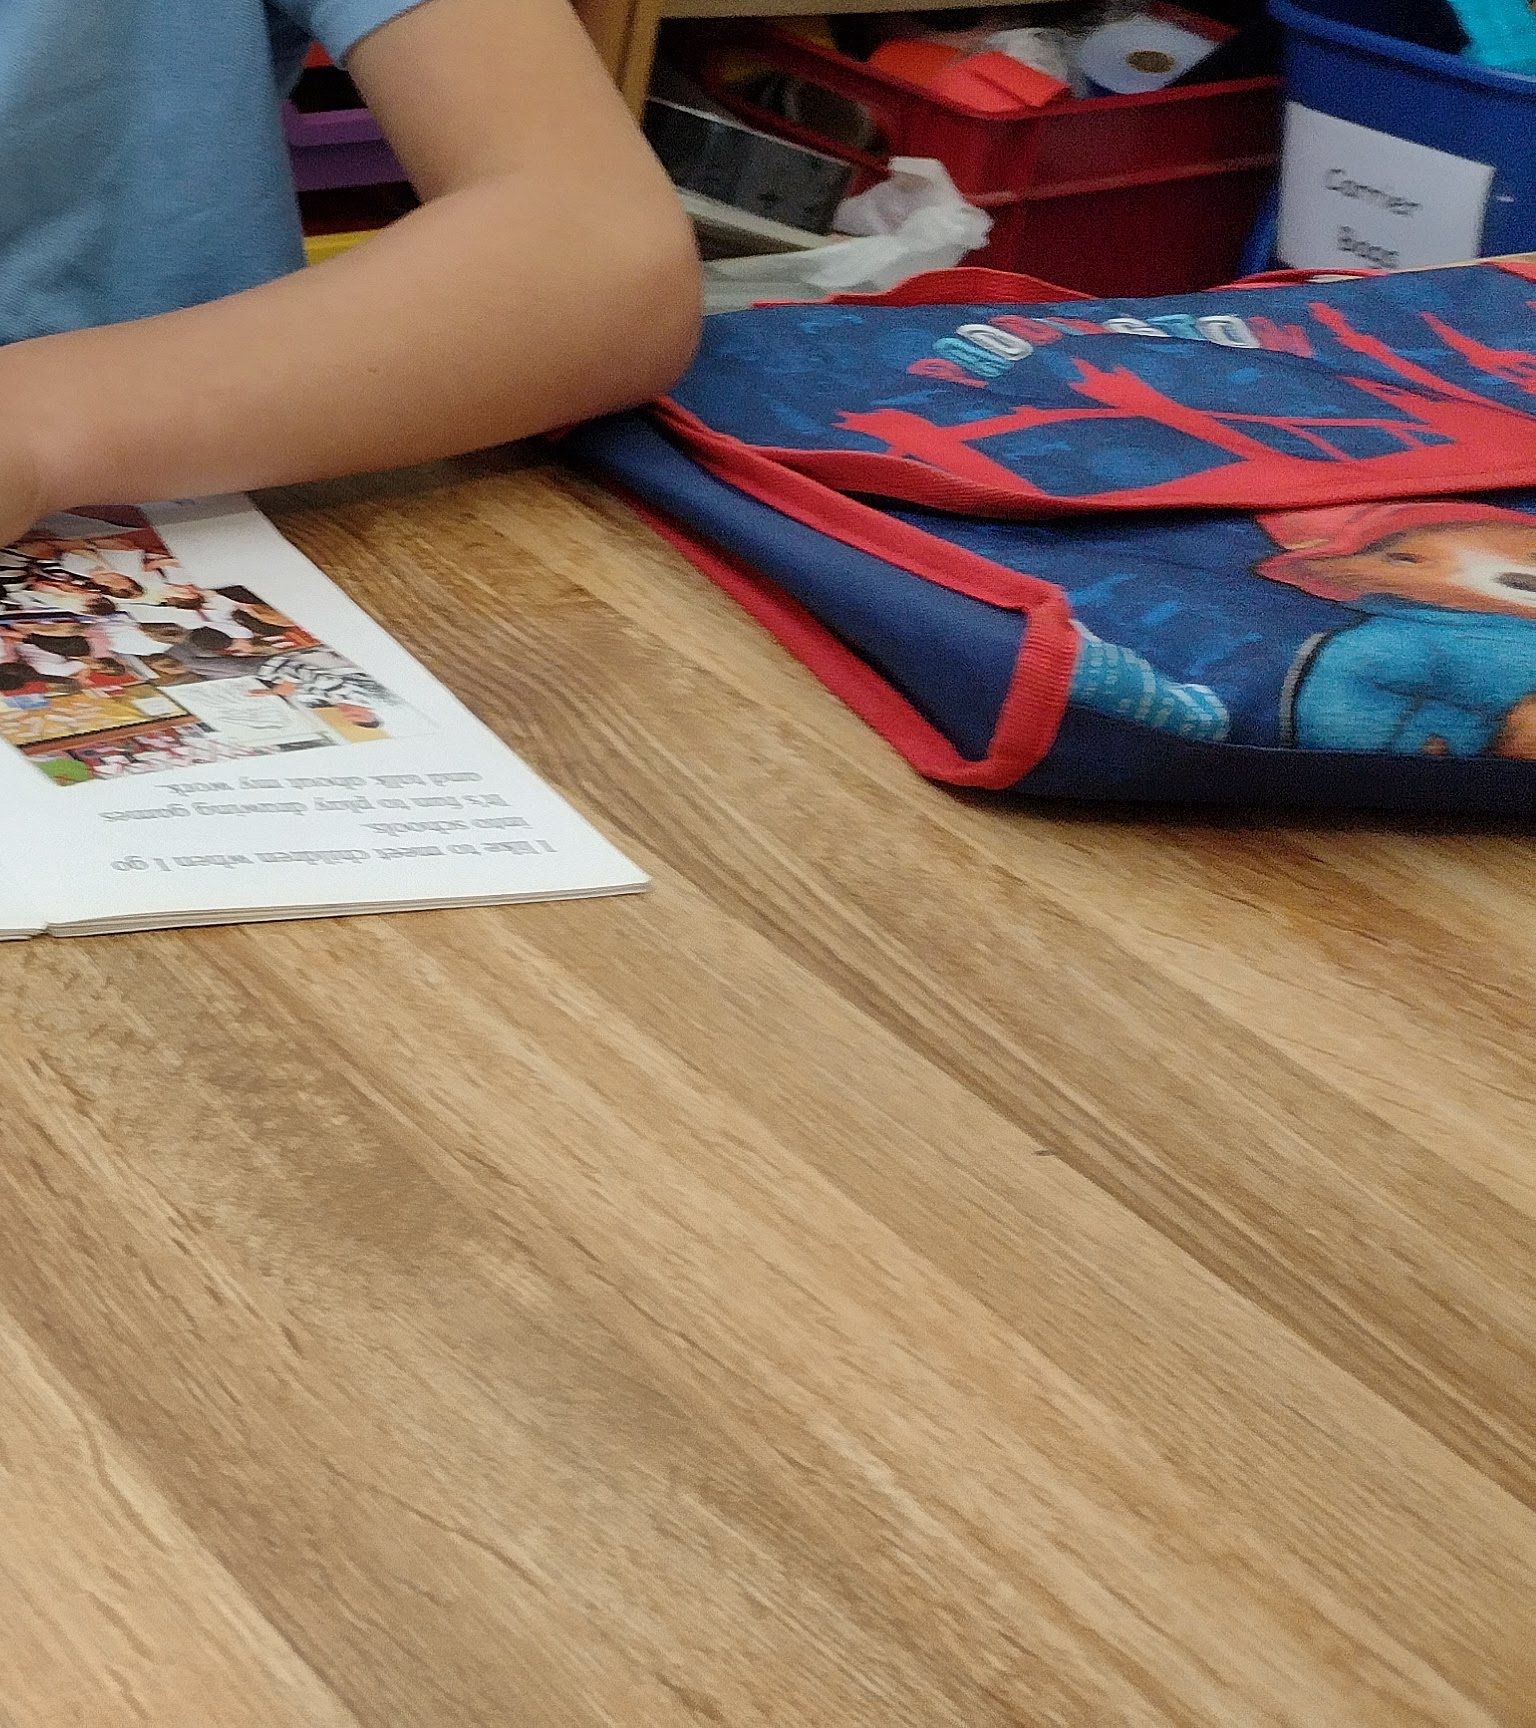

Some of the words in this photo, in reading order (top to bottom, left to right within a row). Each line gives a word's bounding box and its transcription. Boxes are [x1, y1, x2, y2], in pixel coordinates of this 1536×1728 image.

[238, 776, 284, 790] my
[284, 776, 367, 791] about
[425, 772, 483, 787] and
[191, 802, 308, 816] drawing
[313, 795, 376, 814] play
[376, 798, 410, 810] to
[97, 803, 191, 822] games
[372, 846, 446, 860] meet
[446, 844, 481, 856] to
[111, 855, 149, 872] go
[172, 855, 254, 869] when
[254, 849, 371, 866] children
